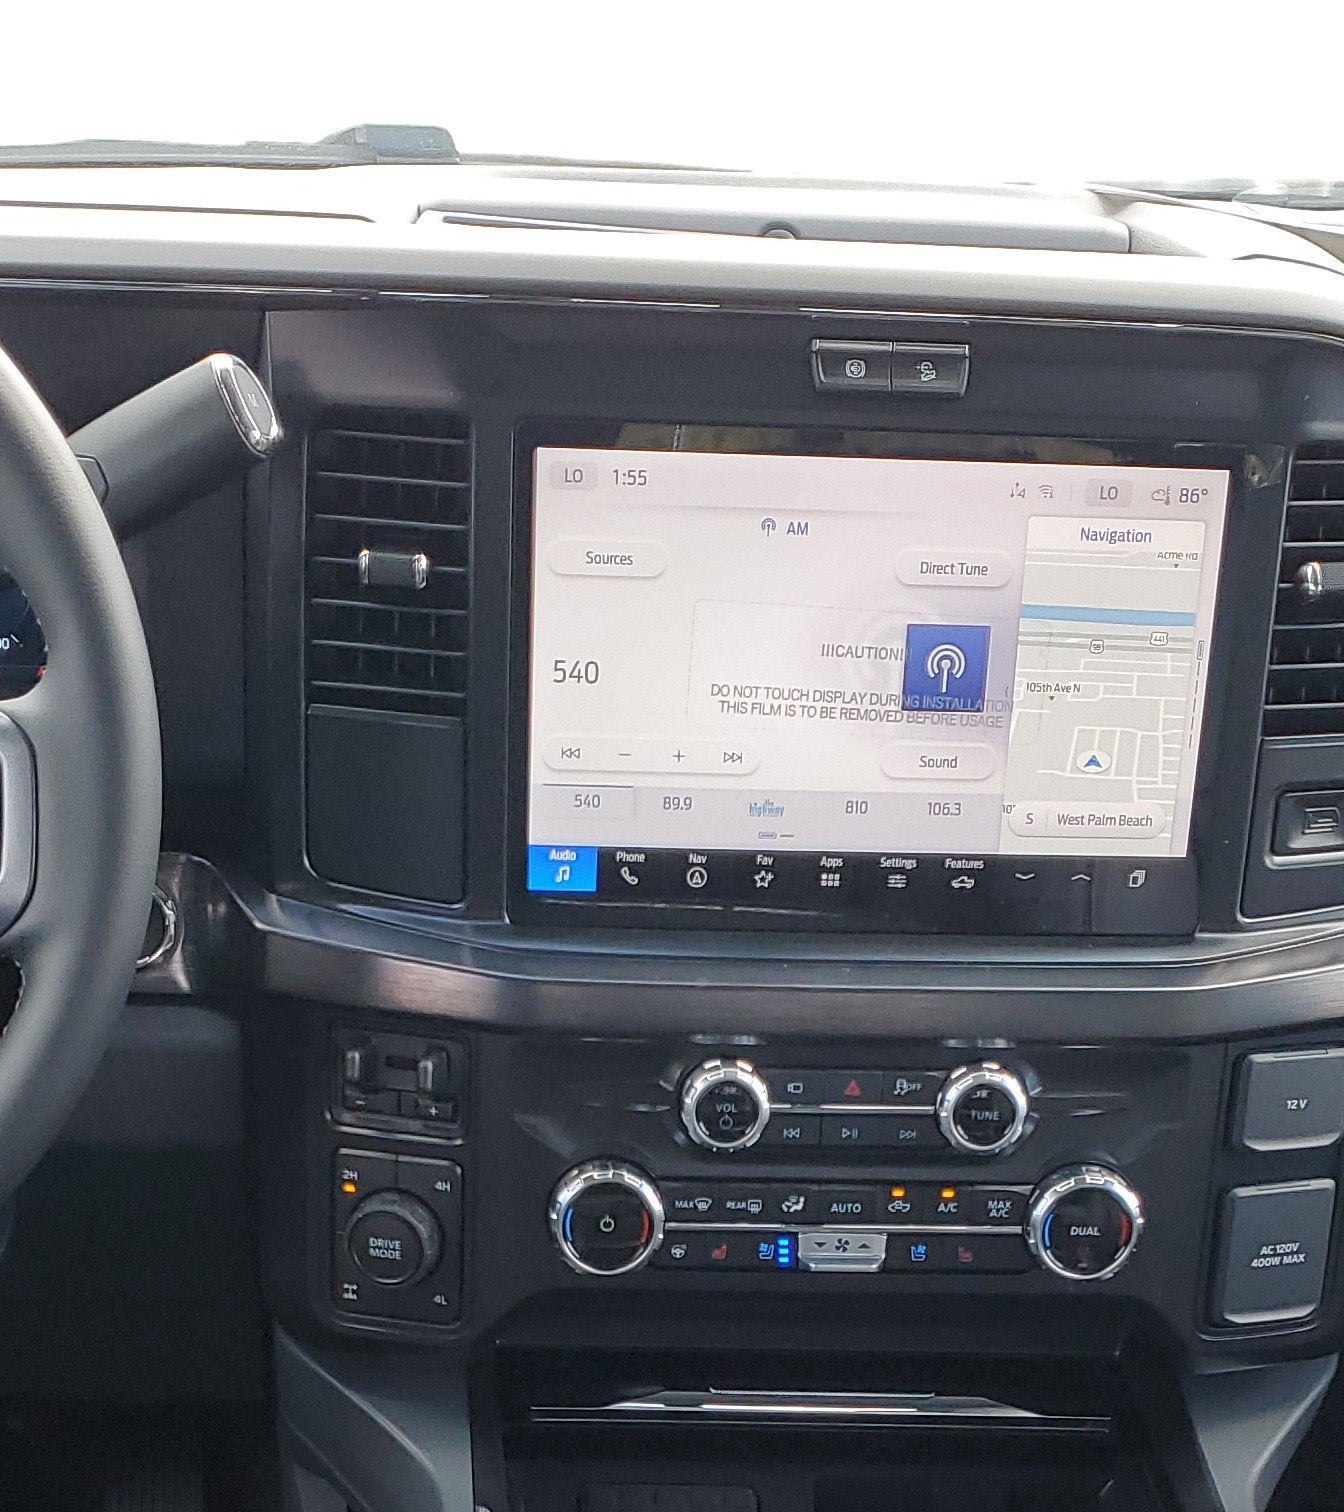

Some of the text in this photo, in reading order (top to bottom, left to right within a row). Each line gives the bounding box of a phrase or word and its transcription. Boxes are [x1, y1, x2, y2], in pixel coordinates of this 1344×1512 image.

[564, 467, 583, 484] LO
[612, 468, 647, 486] 1:55
[1099, 486, 1118, 500] LO
[1178, 486, 1209, 503] 86°
[786, 521, 810, 536] AM
[1079, 526, 1153, 545] Navigation
[585, 551, 634, 566] Sources
[919, 560, 989, 577] Direct Tune
[552, 659, 600, 685] 540
[1025, 681, 1082, 695] 105th Ave N
[710, 683, 1013, 713] DO NOT TOUCH DISPLAY DURING INSTALLATION
[718, 699, 1005, 729] THIS FILM IS TO BE REMOVED BEFORE USAGE
[918, 755, 959, 769] Sound
[573, 793, 601, 809] 540
[662, 795, 693, 812] 89.9
[845, 800, 869, 815] 810
[927, 802, 961, 816] 106.3
[1024, 812, 1035, 825] S
[1056, 812, 1154, 828] West Palm Beach
[549, 849, 577, 861] Audio
[616, 850, 646, 863] Phone
[688, 852, 708, 865] Nav
[756, 853, 774, 866] Fav
[820, 855, 844, 869] Apps
[880, 857, 918, 870] Settings
[944, 857, 984, 870] Features
[905, 1083, 922, 1092] OFF
[716, 1103, 738, 1113] VOL
[970, 1109, 1001, 1121] TUNE
[341, 1169, 359, 1181] 2H
[433, 1180, 451, 1193] 4H
[675, 1200, 694, 1210] MAX
[725, 1200, 747, 1211] REAR
[830, 1203, 862, 1214] AUTO
[937, 1202, 958, 1213] A/C
[987, 1200, 1012, 1210] MAX
[988, 1207, 1010, 1218] A/C
[1070, 1226, 1101, 1237] DUAL
[368, 1237, 402, 1251] DRIVE
[368, 1248, 402, 1260] MODE
[1251, 1253, 1306, 1268] 400W MAX
[433, 1293, 448, 1306] 4L
